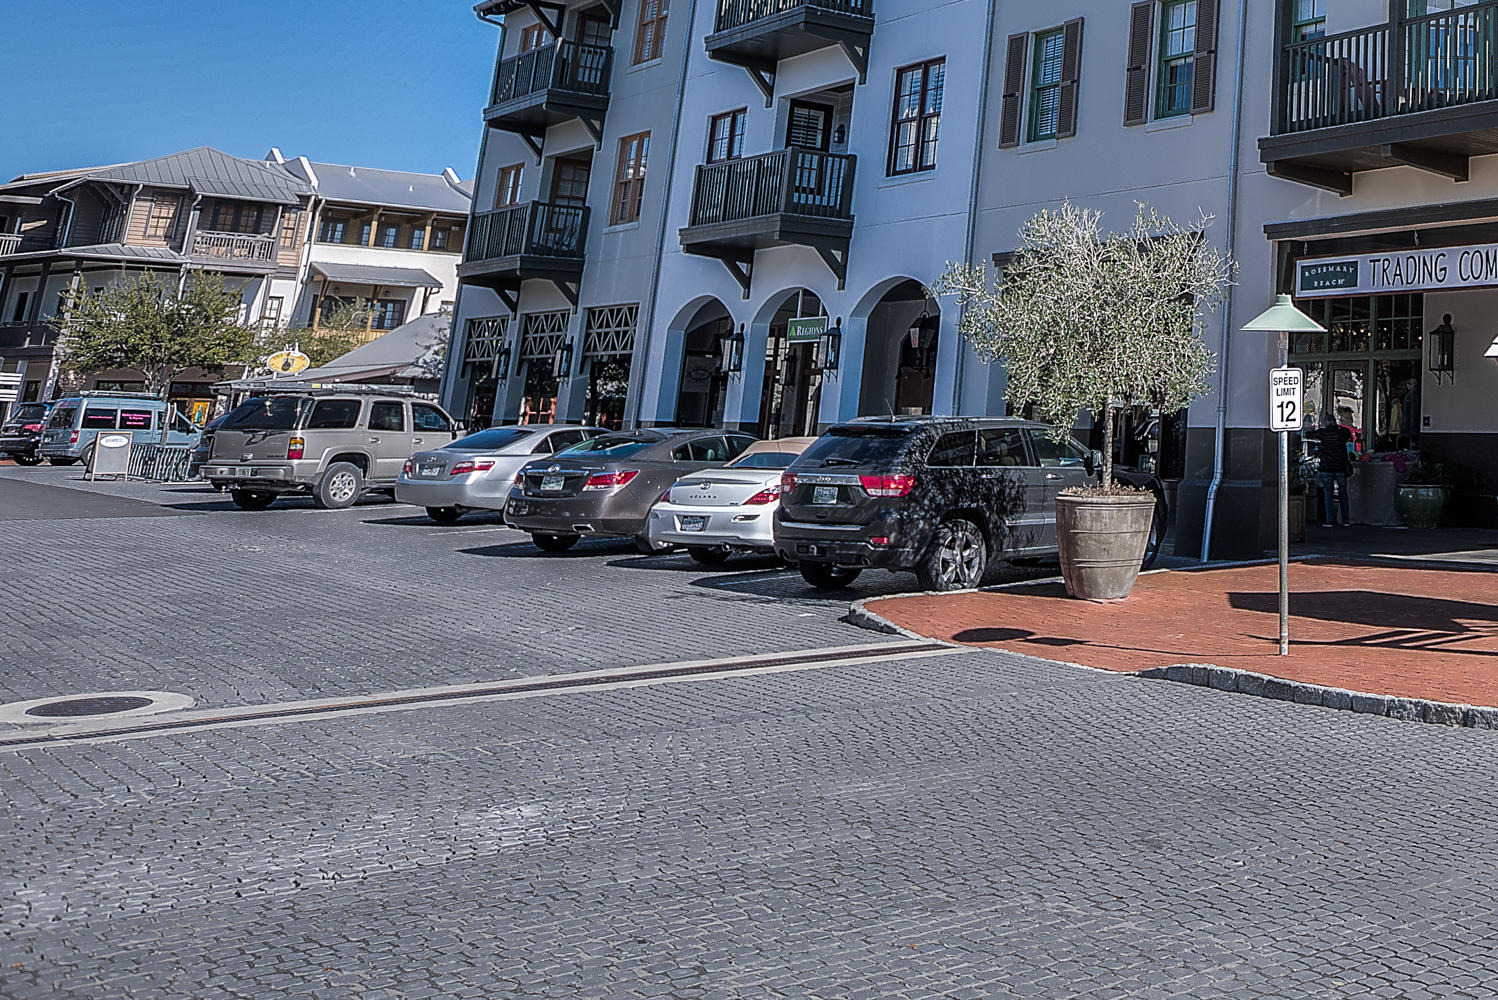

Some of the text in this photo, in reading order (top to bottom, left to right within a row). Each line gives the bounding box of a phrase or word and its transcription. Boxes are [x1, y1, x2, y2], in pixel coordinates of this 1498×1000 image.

[1304, 265, 1354, 277] ROSEMARY
[1369, 252, 1448, 287] TRADING
[1313, 278, 1345, 287] BEACH
[1272, 376, 1299, 386] SPEED
[1276, 387, 1296, 397] LIMIT
[1276, 400, 1297, 423] 12
